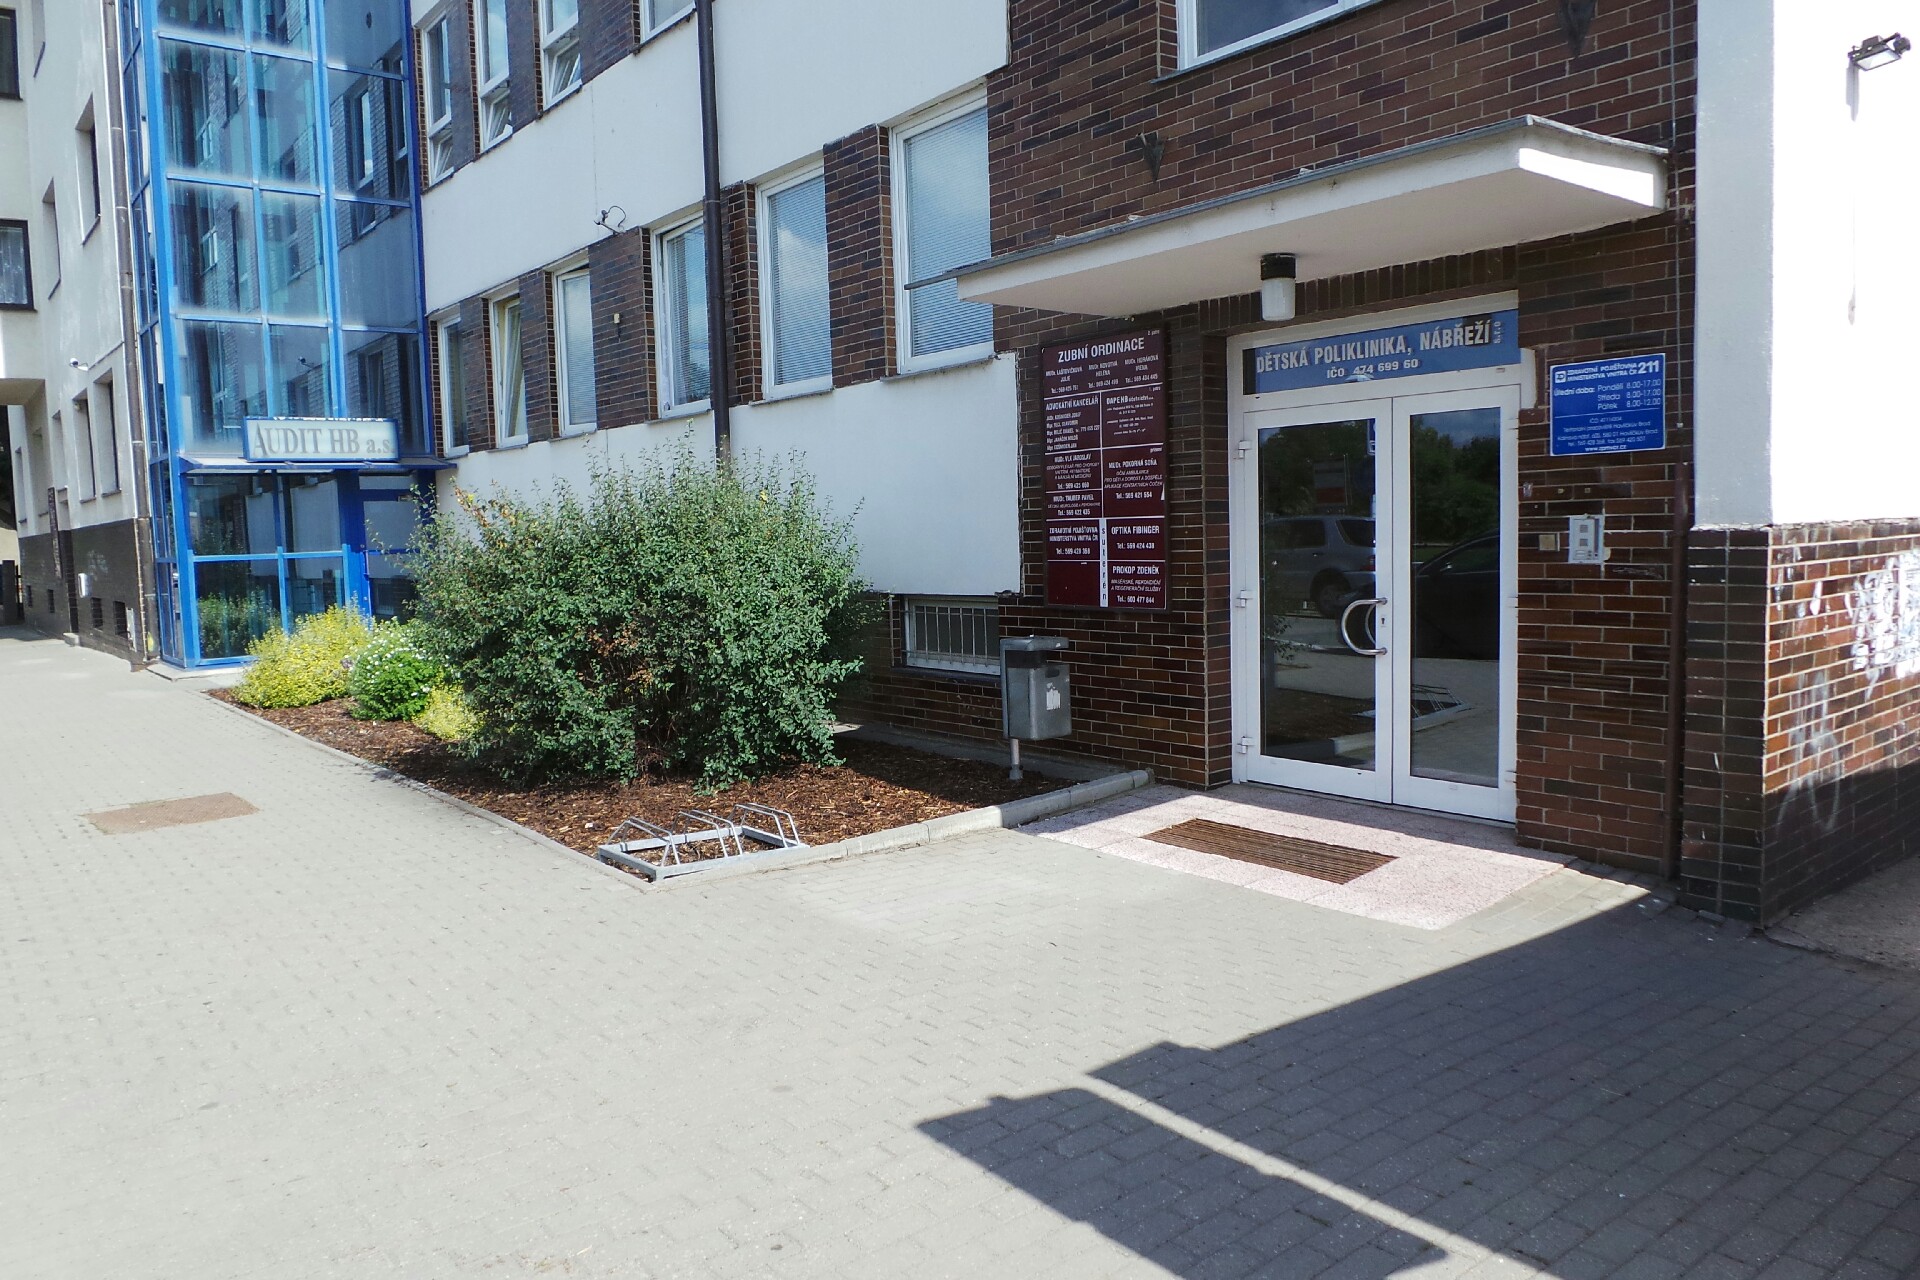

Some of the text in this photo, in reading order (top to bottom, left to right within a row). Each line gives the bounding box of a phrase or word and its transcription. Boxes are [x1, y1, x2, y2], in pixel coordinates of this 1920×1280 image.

[1058, 337, 1145, 363] ZUBNÍ ORDINACE
[1256, 319, 1492, 374] DĚTSKÁ POLIKLINIKA, NÁBŘEŽÍ
[1326, 358, 1419, 378] IČO 474 699 60
[1567, 362, 1637, 376] ZDRAVOTNÍ POJIŠŤOVNA
[1638, 360, 1659, 374] 211
[1567, 373, 1605, 382] MINISTERSTVA
[1606, 370, 1628, 378] VNITRA
[1598, 382, 1624, 392] Pondělí
[1046, 400, 1073, 410] ADVOKÁTNÍ
[1073, 396, 1099, 407] KANCELÁŘ
[1598, 402, 1618, 410] Pátek
[253, 423, 322, 458] AUDIT
[328, 428, 360, 454] HB
[1123, 459, 1143, 467] POKORNÁ
[1145, 458, 1157, 466] SOŇA
[1111, 525, 1160, 534] OPTIKA FIBINGER
[1112, 564, 1159, 574] PROKOP ZDENĚK
